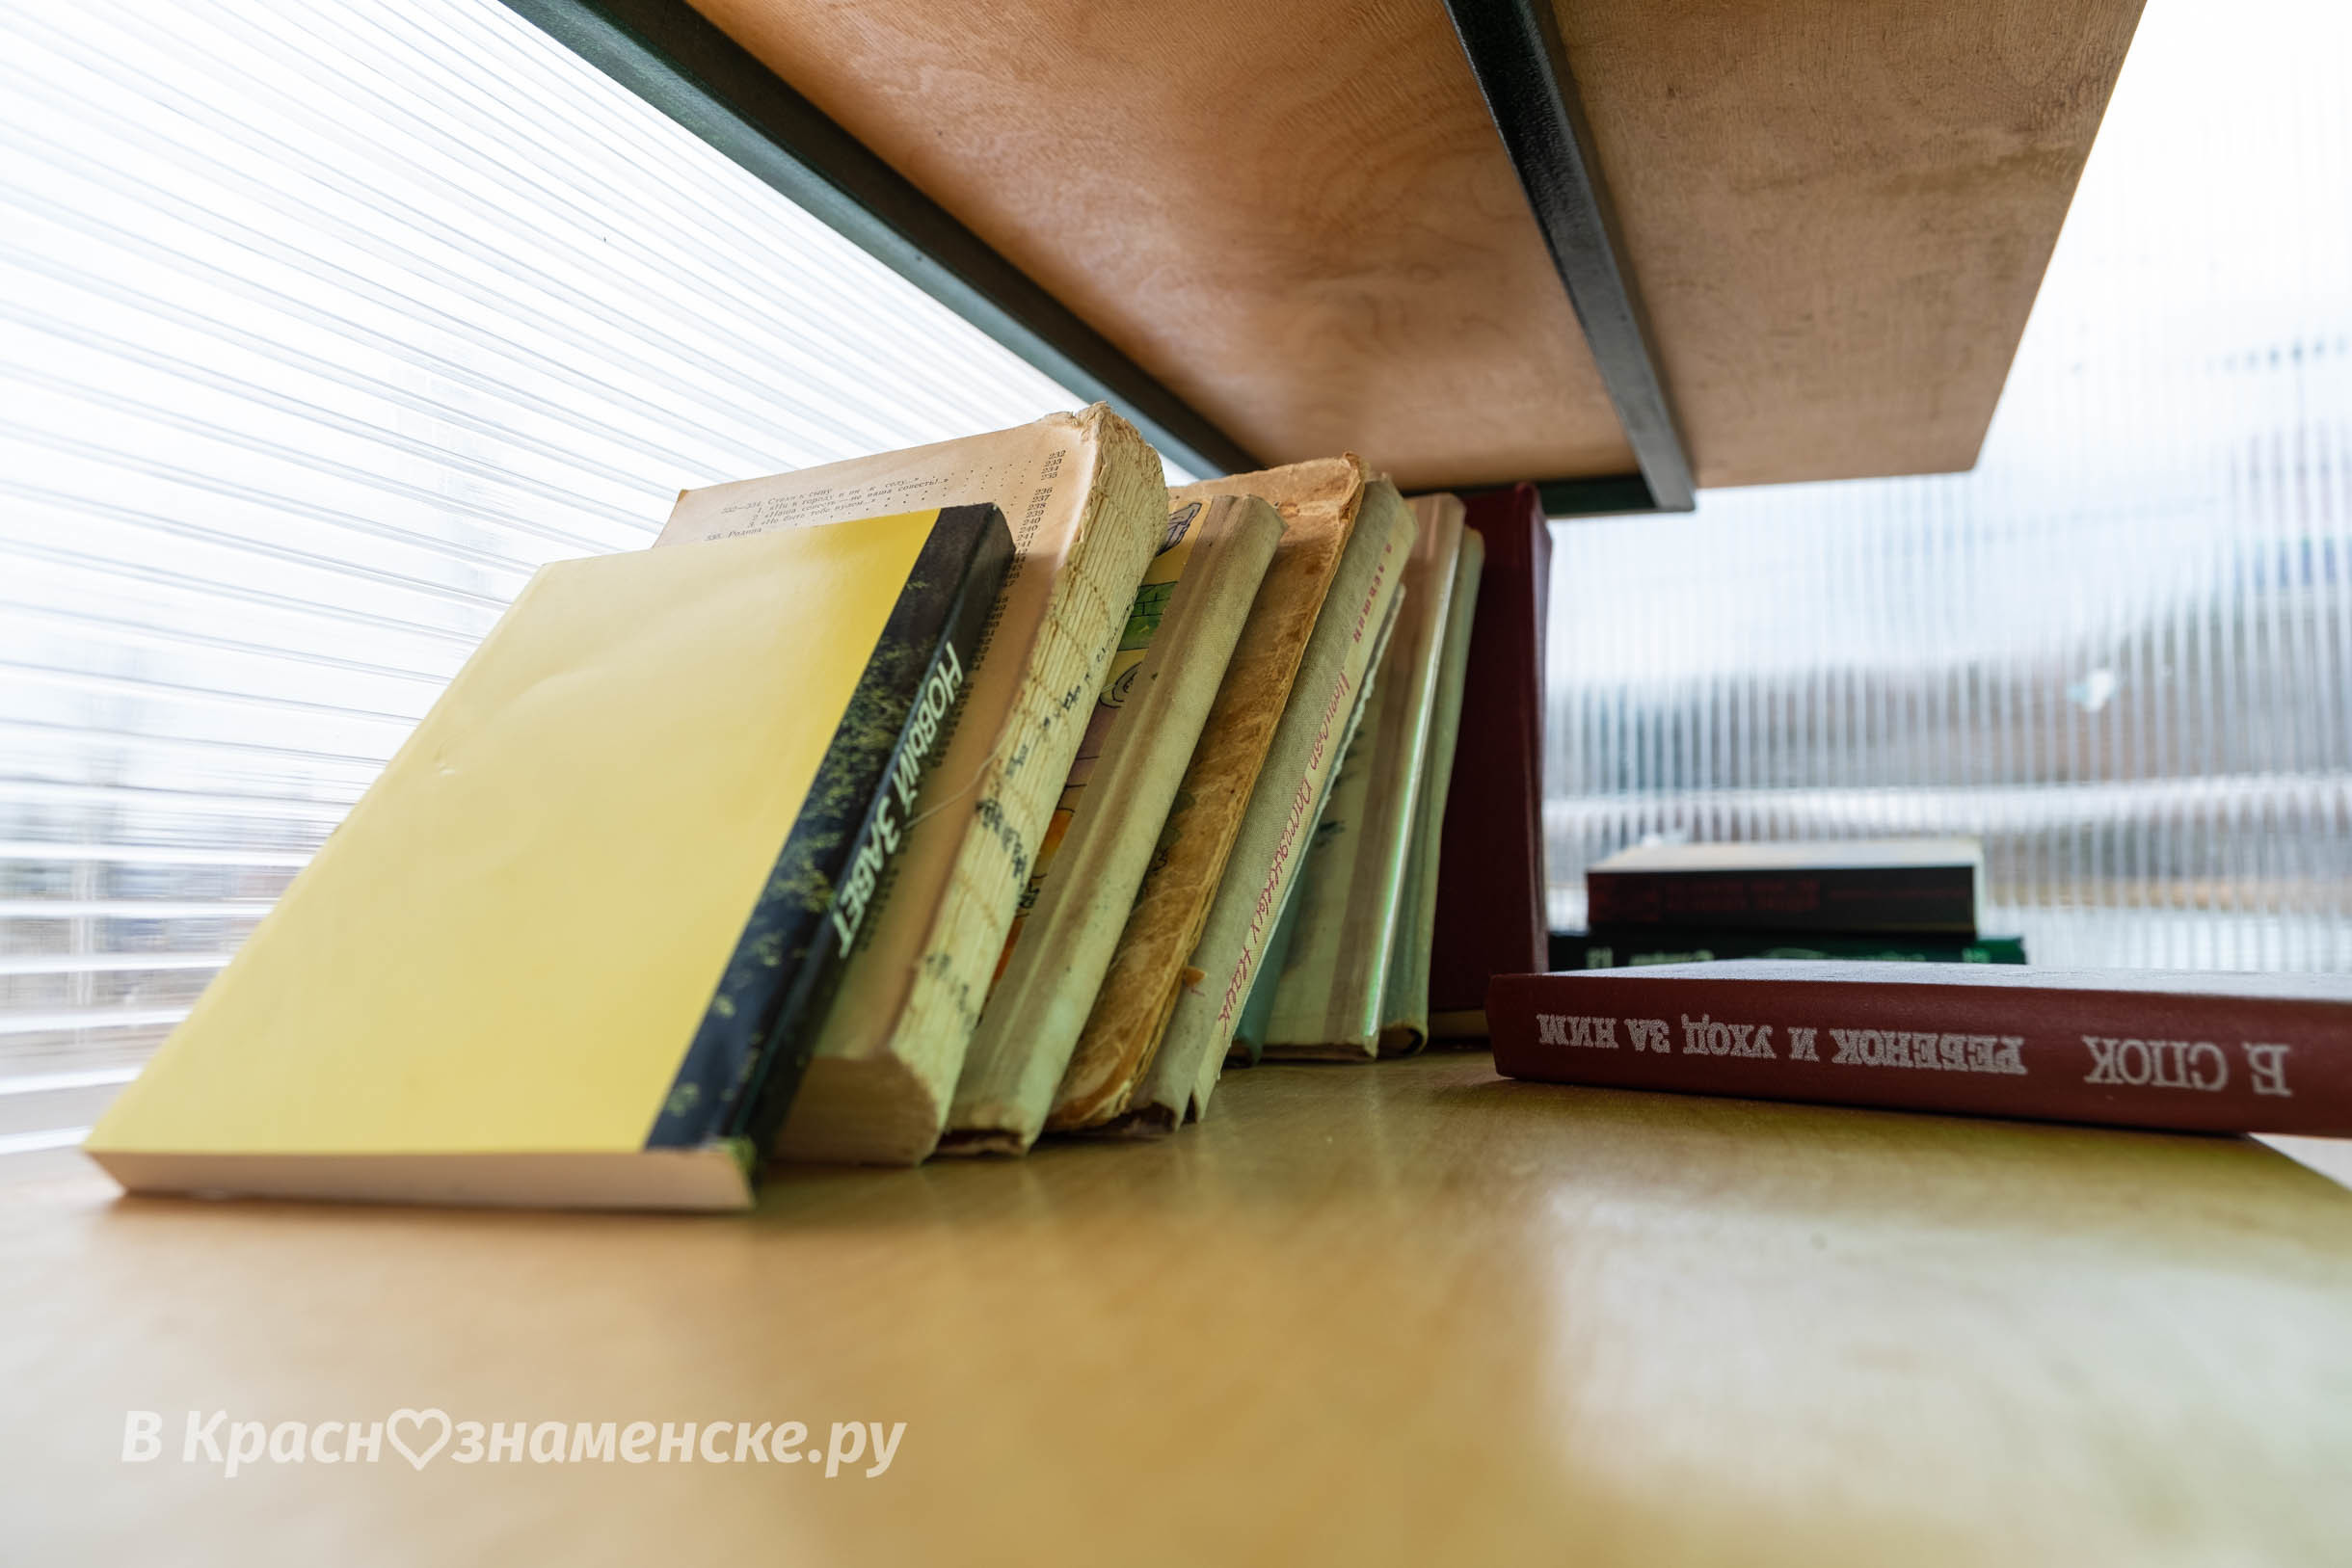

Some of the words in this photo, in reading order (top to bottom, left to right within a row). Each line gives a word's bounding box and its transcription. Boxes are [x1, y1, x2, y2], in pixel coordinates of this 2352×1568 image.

[1031, 494, 1051, 503] 237
[1034, 487, 1053, 495] 236
[1019, 524, 1038, 533] 240
[1022, 517, 1041, 525] 240
[1026, 510, 1044, 518] 239
[892, 640, 964, 817] НОВЫЙ
[832, 795, 901, 959] ЗАВЕТ
[1536, 1013, 1619, 1050] НИМ
[1624, 1018, 1671, 1053] ЗА
[1680, 1013, 1777, 1059] УХОД
[1787, 1025, 1820, 1062] И
[1829, 1028, 2028, 1076] РЕБЕНОК
[2080, 1034, 2229, 1091] СПОК
